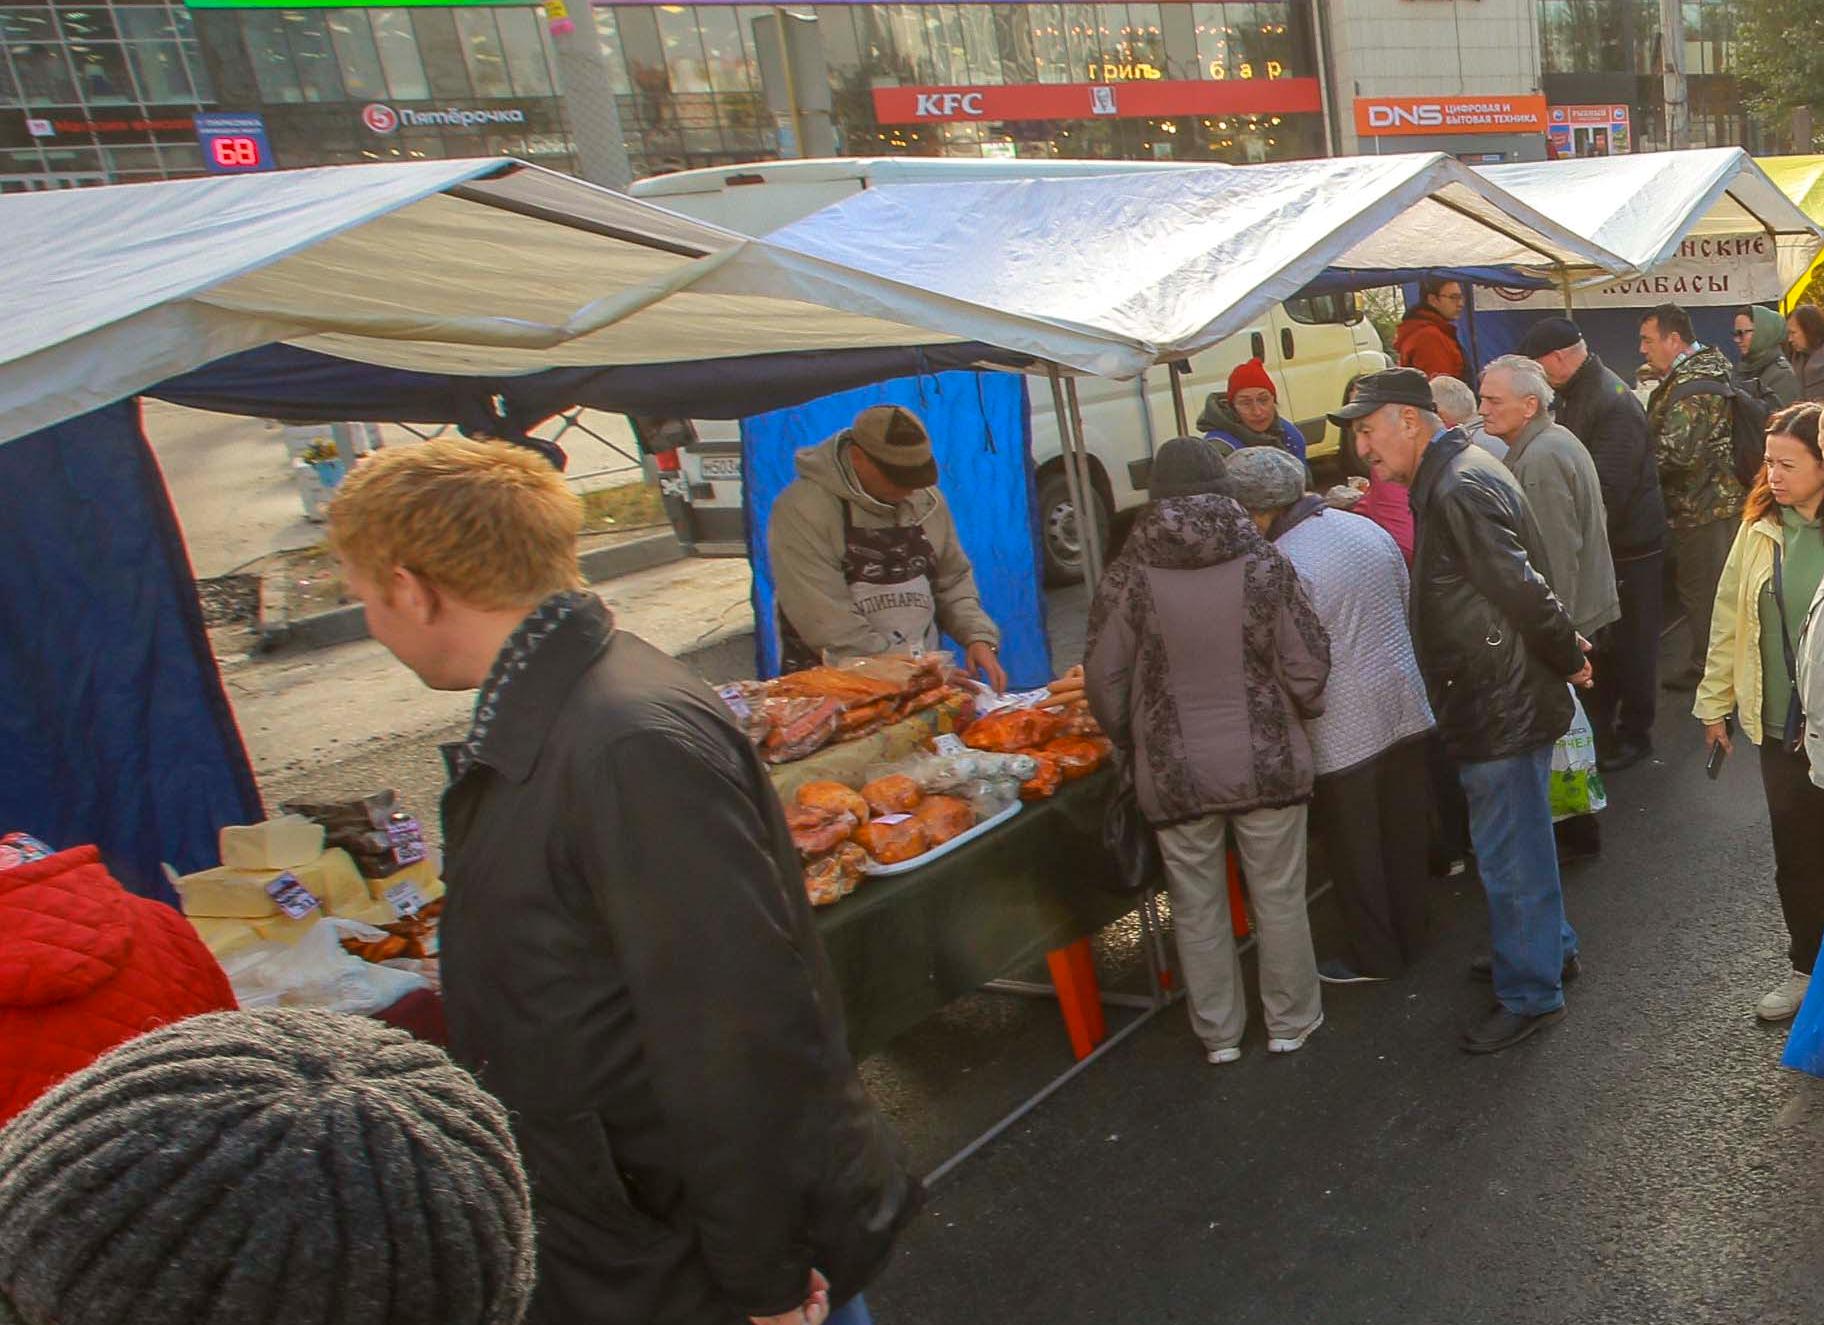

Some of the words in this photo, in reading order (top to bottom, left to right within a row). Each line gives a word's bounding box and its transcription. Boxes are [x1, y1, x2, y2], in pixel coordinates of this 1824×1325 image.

[915, 93, 984, 116] KFC
[1445, 103, 1500, 114] ЦИФРОВАЯ
[1502, 103, 1511, 112] И
[400, 107, 525, 127] Пятёрочка
[1367, 105, 1443, 127] DNS
[1446, 114, 1491, 125] БЫТОВАЯ
[1494, 113, 1538, 124] ТЕХНИКА
[212, 136, 260, 168] 68
